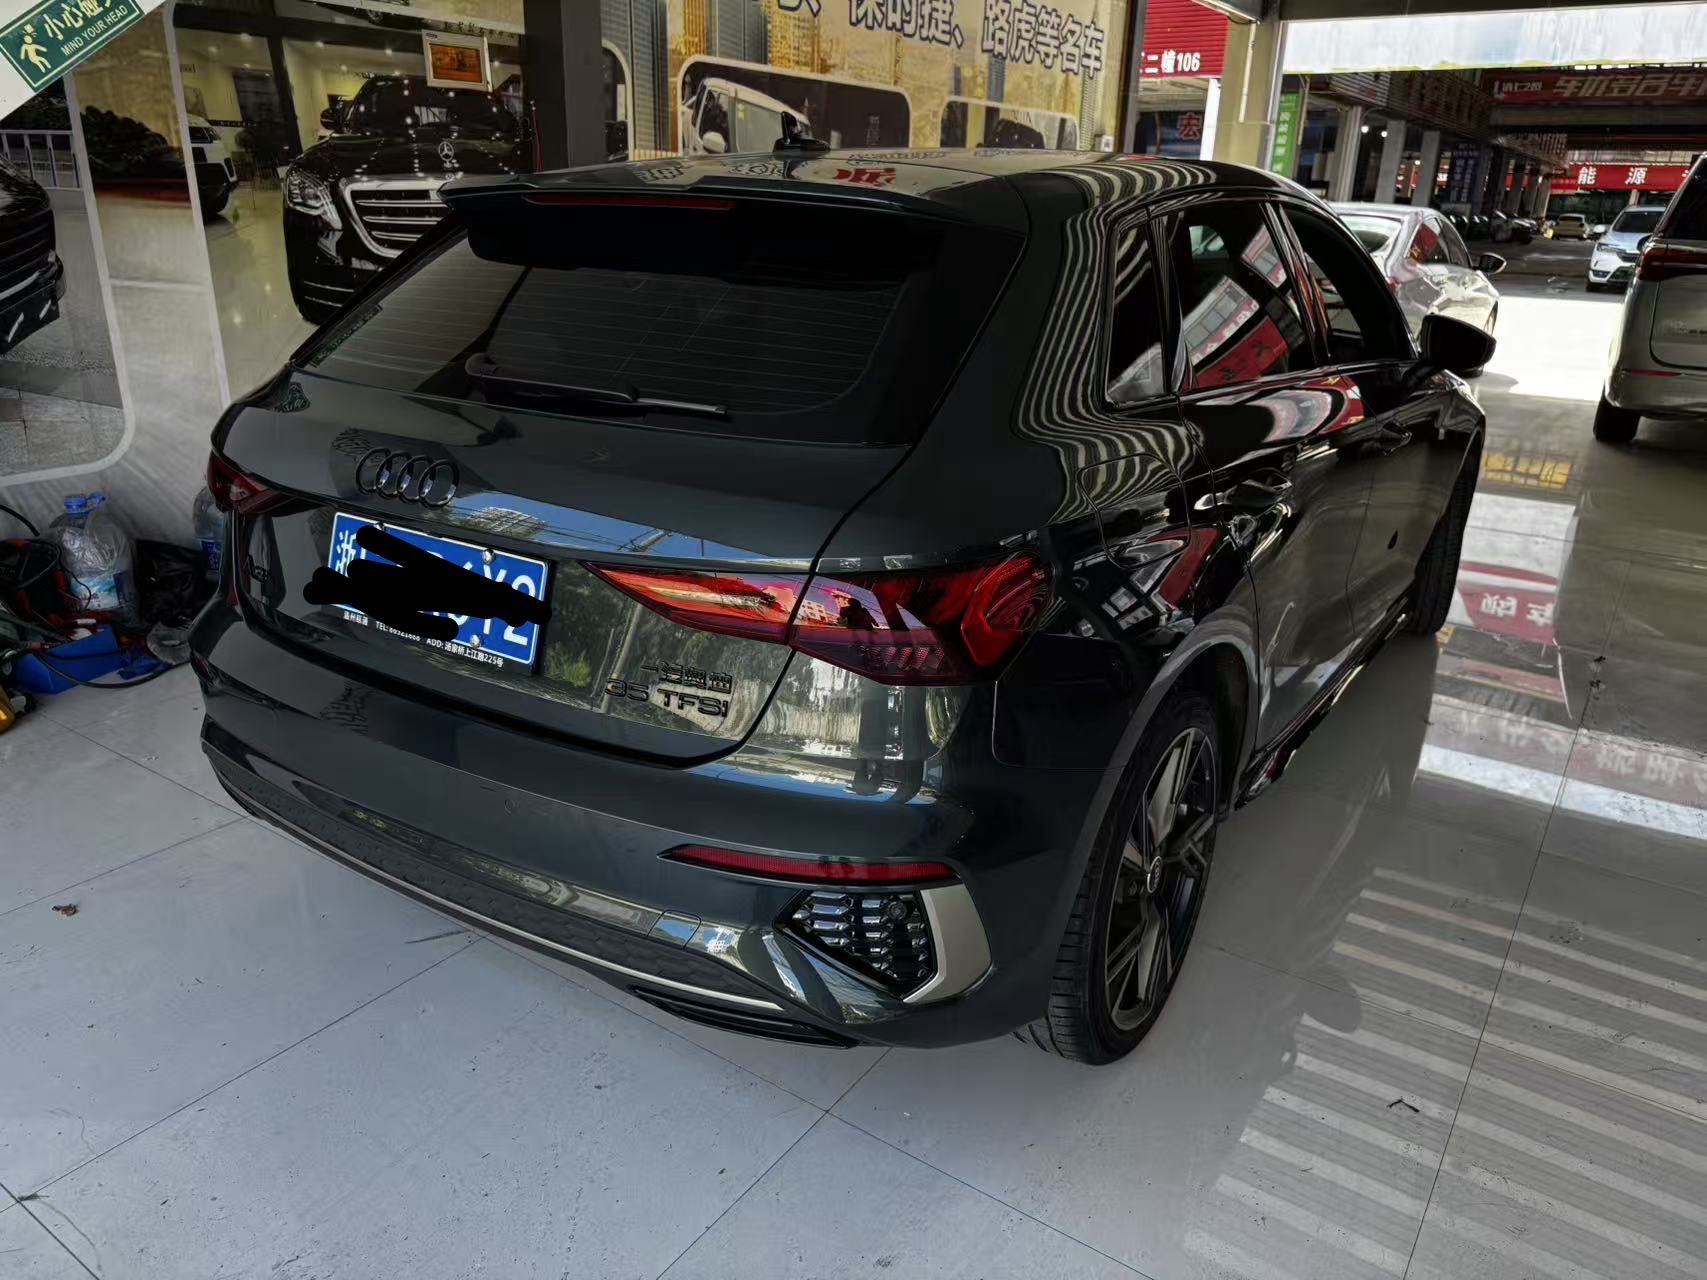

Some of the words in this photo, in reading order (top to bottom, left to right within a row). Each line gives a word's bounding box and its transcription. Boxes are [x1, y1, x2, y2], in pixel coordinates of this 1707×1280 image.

[60, 37, 83, 56] MIND
[81, 20, 107, 41] YOUR
[104, 5, 128, 25] HEAD
[605, 679, 649, 702] 35
[657, 688, 729, 718] TFSI
